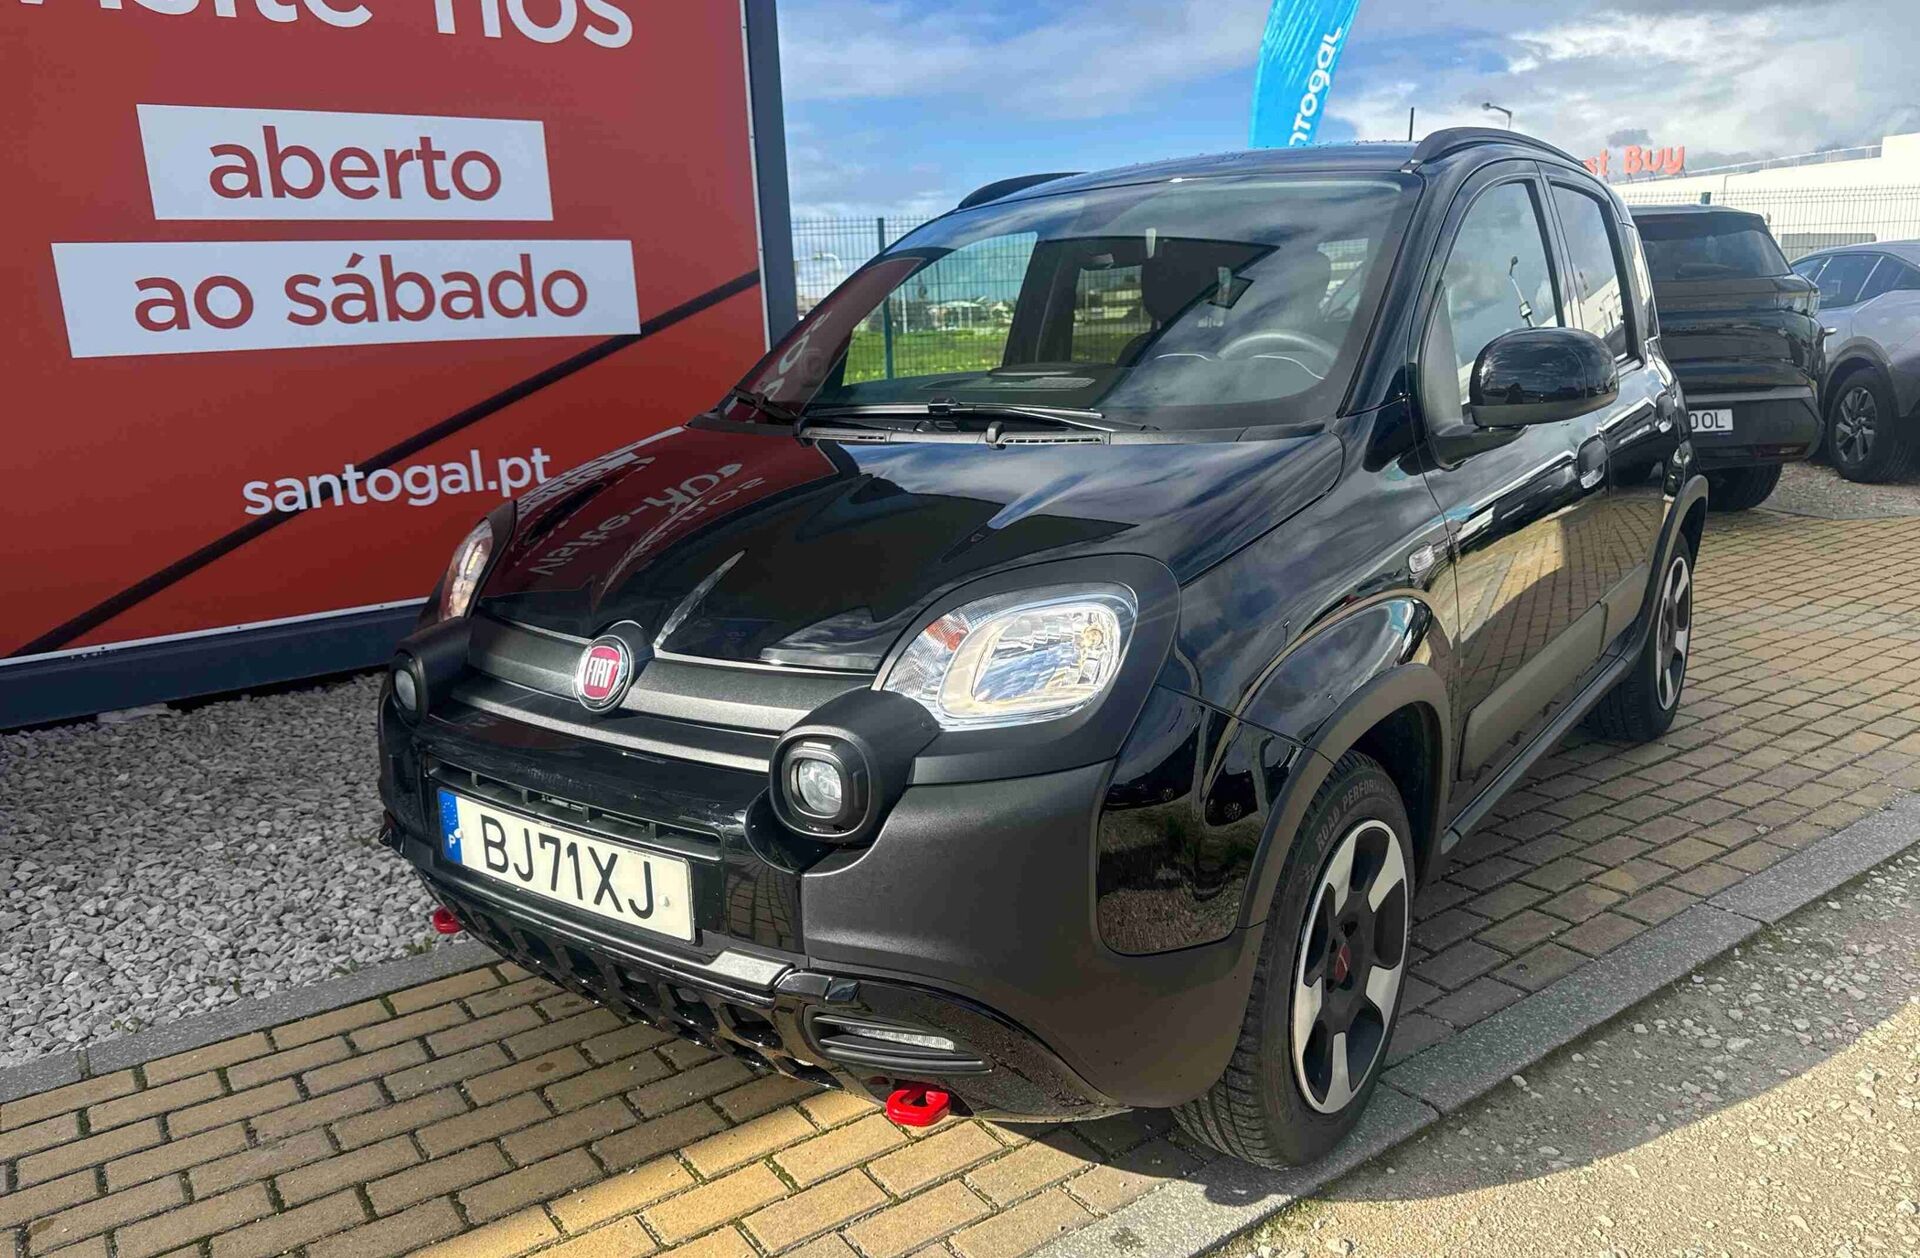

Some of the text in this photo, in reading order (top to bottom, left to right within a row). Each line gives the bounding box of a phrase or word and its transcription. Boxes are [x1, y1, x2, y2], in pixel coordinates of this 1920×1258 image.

[209, 125, 501, 201] aberto
[1624, 145, 1685, 175] Buy
[134, 252, 588, 332] ao sábado
[242, 448, 552, 515] santogal.pt
[585, 657, 617, 688] FIAT
[447, 834, 457, 848] P
[1315, 807, 1340, 852] ROAD
[480, 814, 654, 919] BJ71XJ
